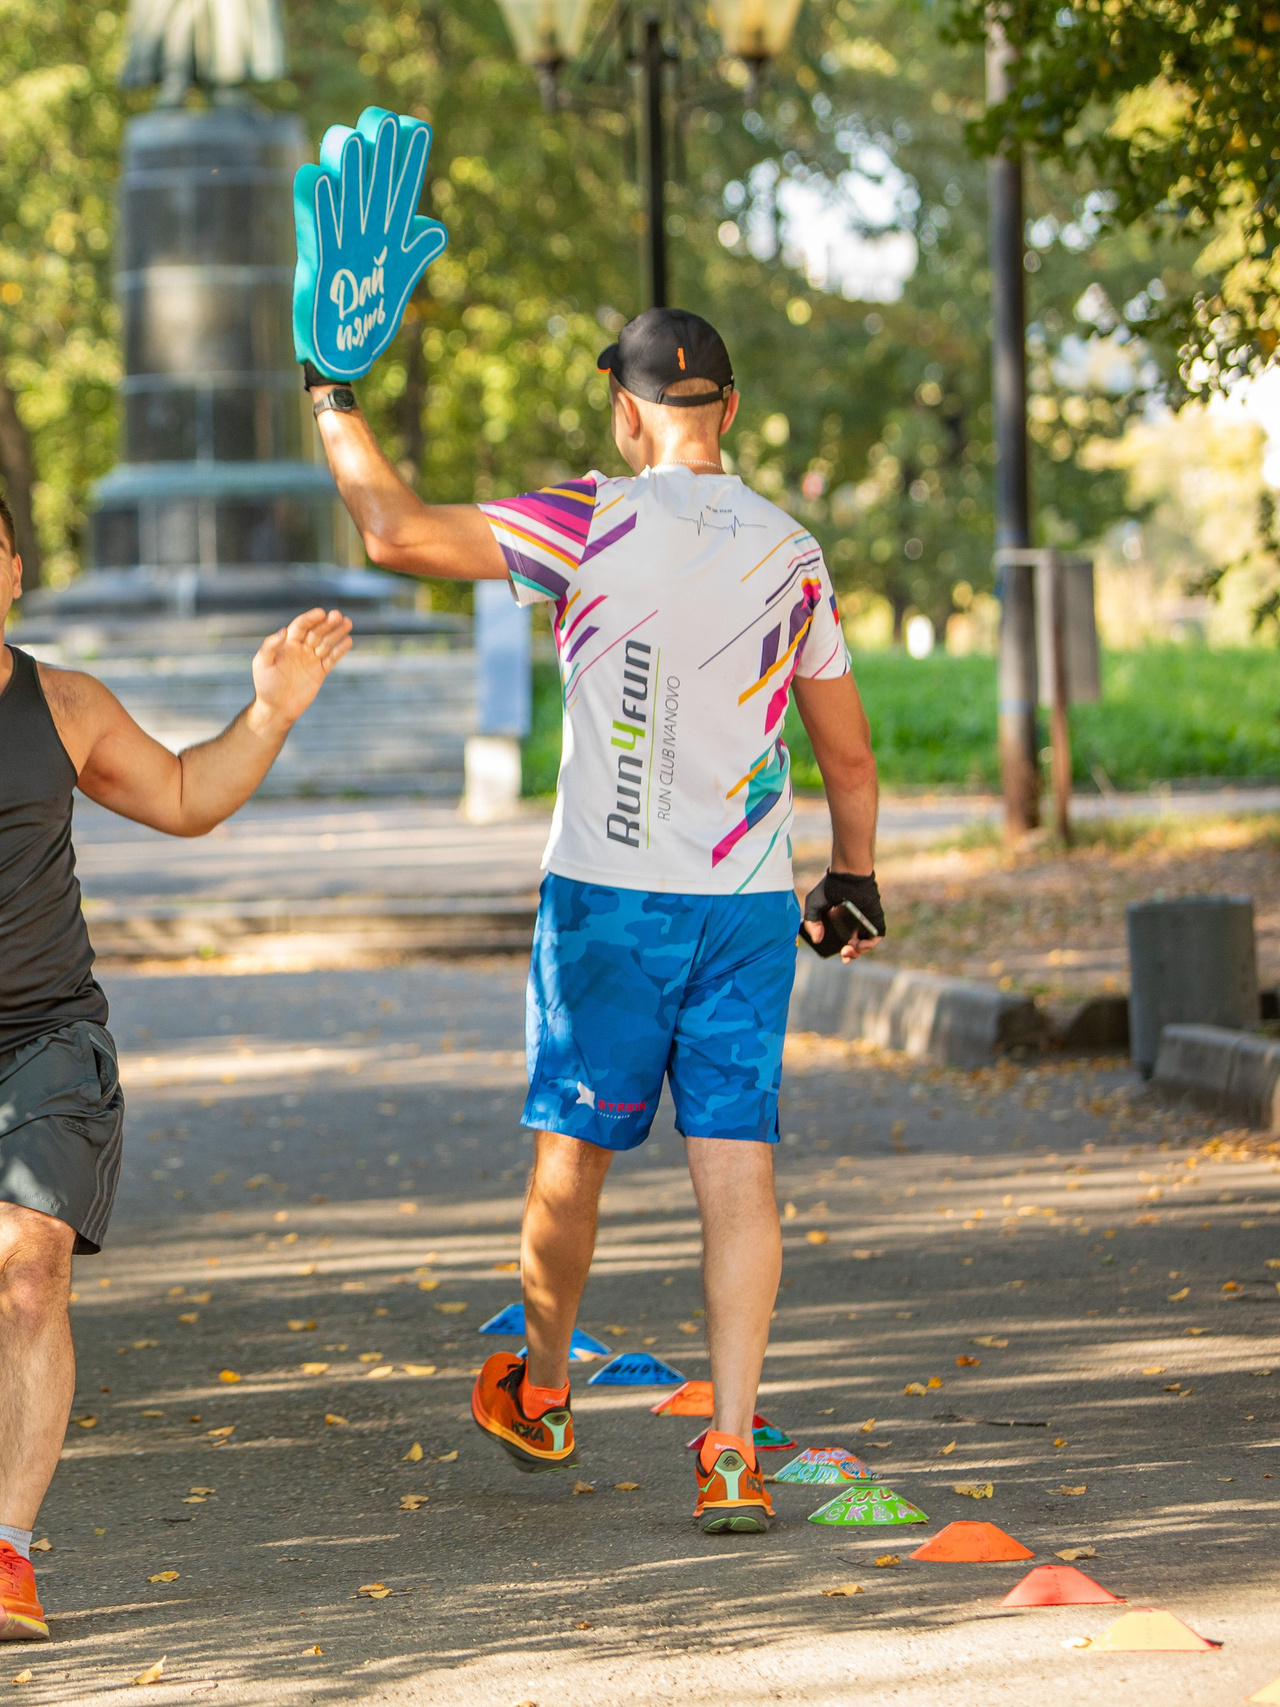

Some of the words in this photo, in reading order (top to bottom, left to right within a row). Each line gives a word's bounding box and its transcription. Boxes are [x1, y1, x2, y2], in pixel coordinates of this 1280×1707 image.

[330, 245, 387, 321] Дай
[336, 297, 386, 351] пять
[663, 676, 681, 747] IVANOVO
[660, 748, 675, 786] CLUB
[658, 788, 672, 821] RUN
[63, 1119, 90, 1136] adidas
[511, 1419, 545, 1443] HOKA
